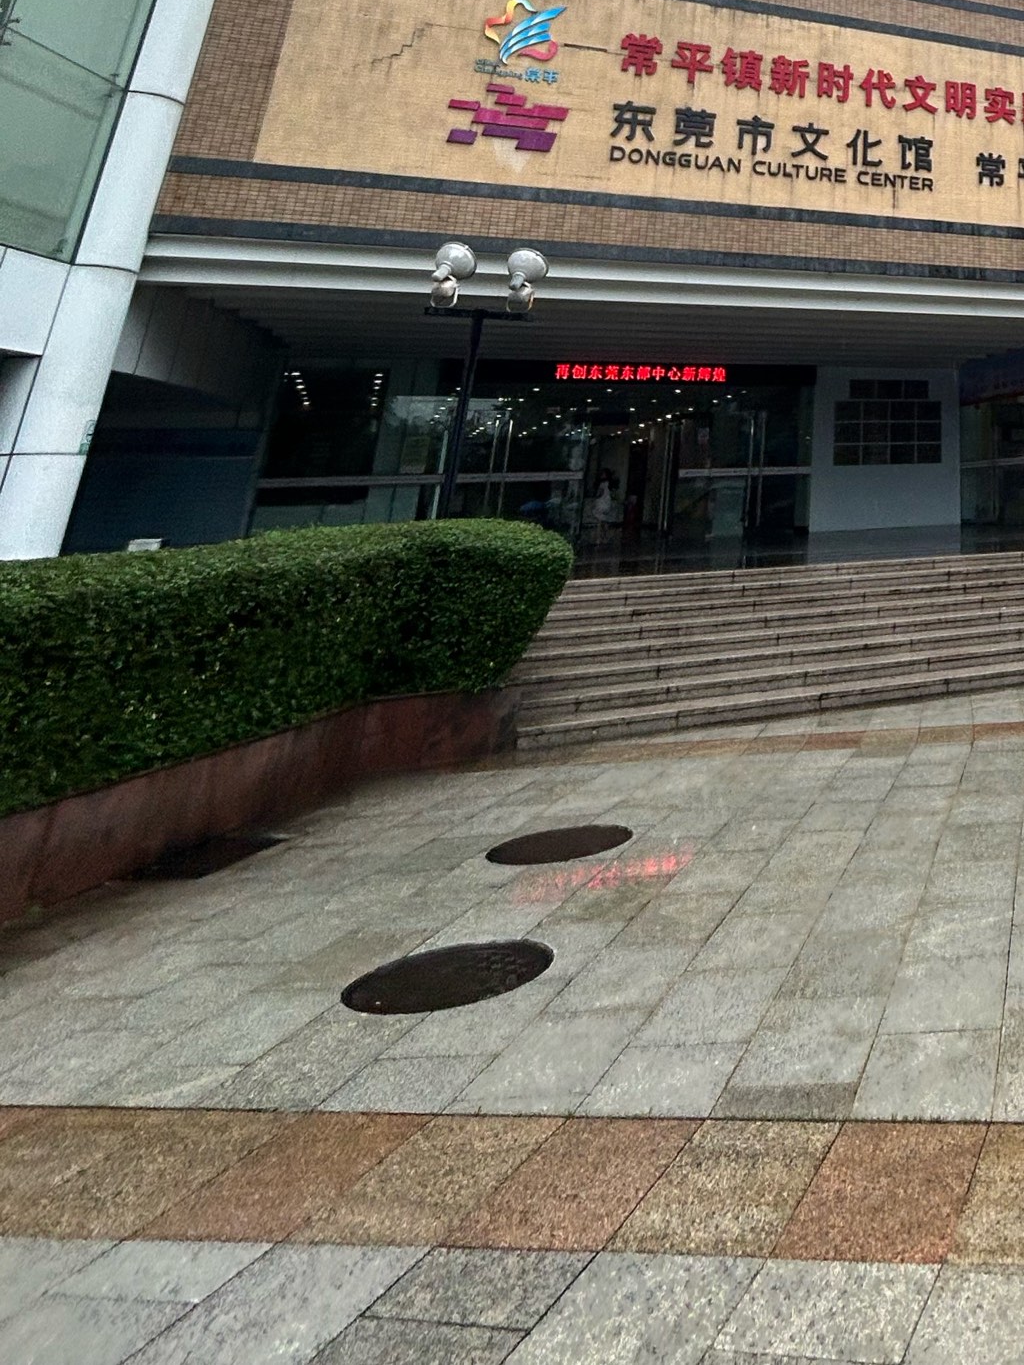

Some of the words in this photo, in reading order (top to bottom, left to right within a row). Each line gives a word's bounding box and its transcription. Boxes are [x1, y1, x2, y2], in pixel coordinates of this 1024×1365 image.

[610, 100, 934, 173] 东莞市文化馆
[609, 145, 741, 174] DONGGUAN
[752, 160, 847, 185] CULTURE
[856, 170, 934, 192] CENTER
[554, 363, 727, 382] 再创东莞东部中心新辉煌
